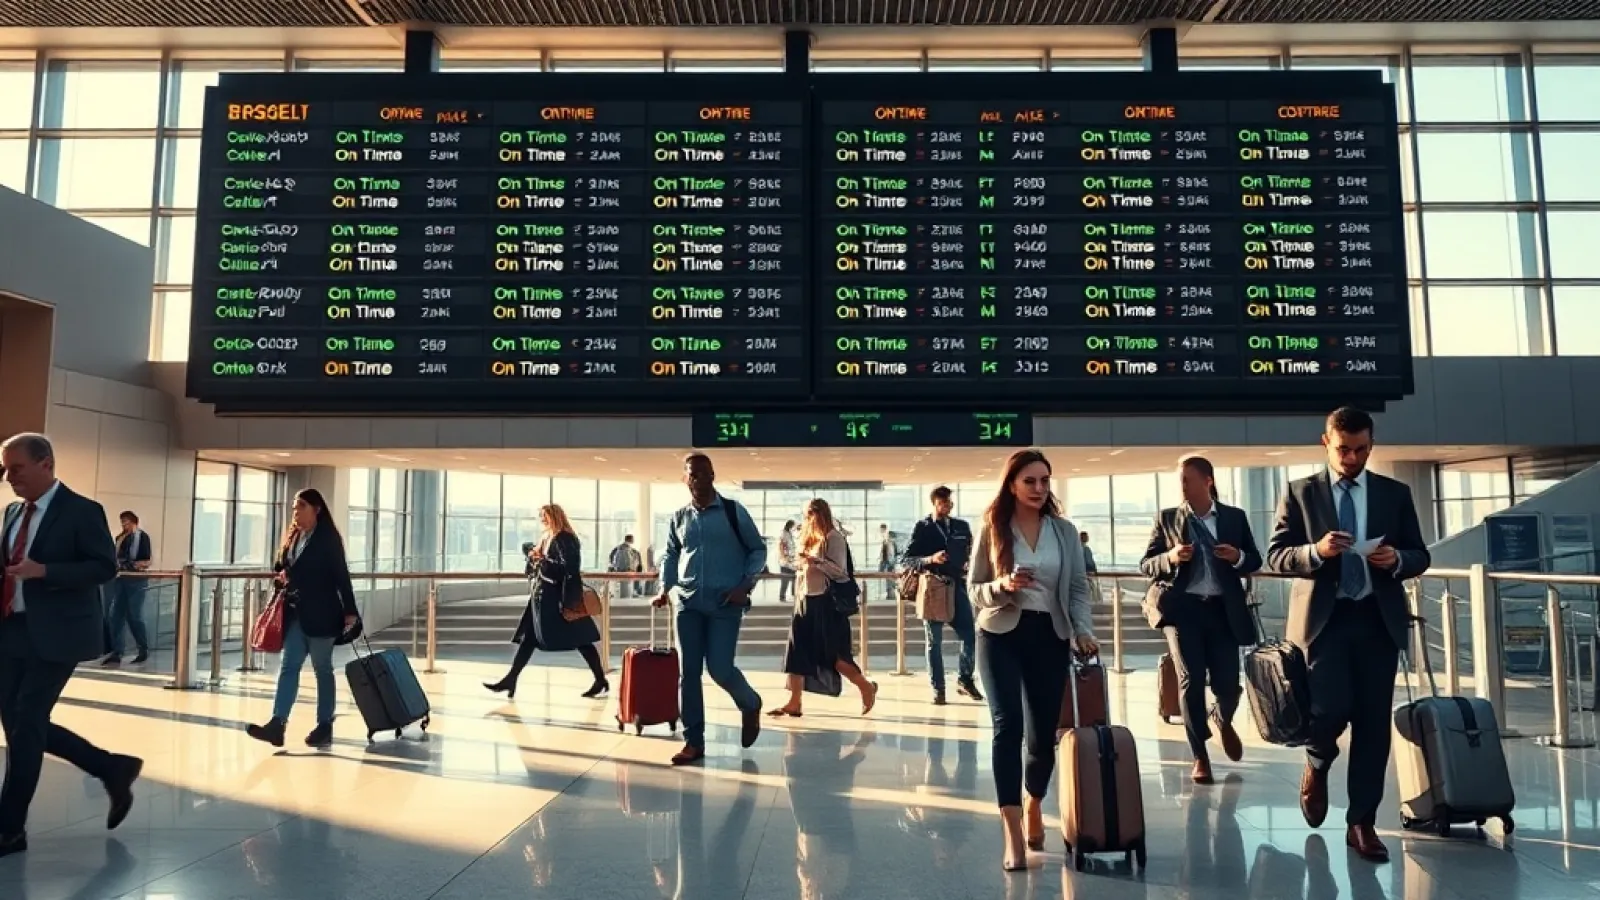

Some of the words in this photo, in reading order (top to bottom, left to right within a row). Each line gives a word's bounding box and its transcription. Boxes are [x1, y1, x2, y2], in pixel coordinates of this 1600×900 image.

[335, 130, 358, 144] On
[499, 131, 522, 144] On
[654, 130, 678, 143] On
[835, 130, 859, 144] On
[1080, 130, 1104, 143] On
[1238, 129, 1261, 143] On
[335, 149, 358, 162] On
[499, 148, 522, 162] On
[654, 147, 679, 162] On
[835, 148, 859, 162] On
[1080, 147, 1106, 161] On
[1239, 147, 1263, 160] On
[333, 177, 356, 190] On
[497, 177, 522, 190] On
[653, 176, 678, 191] On
[836, 177, 859, 190] On
[1082, 177, 1106, 190] On
[1240, 175, 1263, 190] On
[332, 194, 356, 209] On
[496, 194, 521, 209] On
[653, 194, 678, 208] On
[835, 194, 859, 208] On
[1081, 194, 1106, 208] On
[331, 224, 355, 237] On
[496, 224, 519, 237] On
[652, 224, 677, 237] On
[835, 224, 859, 237] On
[1083, 223, 1107, 236] On
[652, 242, 676, 253] On
[835, 242, 859, 253] On
[329, 258, 353, 271] On
[494, 258, 519, 271] On
[652, 258, 677, 271] On
[836, 258, 859, 271] On
[1084, 257, 1109, 270] On
[1244, 256, 1268, 270] On
[327, 286, 351, 301] On
[494, 286, 518, 301] On
[652, 286, 677, 301] On
[1084, 285, 1109, 300] On
[1246, 285, 1270, 299] On
[327, 305, 351, 320] On
[493, 304, 517, 319] On
[651, 305, 676, 320] On
[835, 305, 859, 319] On
[1085, 304, 1110, 318] On
[1246, 303, 1271, 317] On
[325, 337, 349, 351] On
[491, 336, 516, 351] On
[651, 336, 675, 351] On
[836, 336, 861, 351] On
[1085, 335, 1111, 351] On
[1248, 335, 1272, 349] On
[324, 360, 349, 376] On
[491, 361, 515, 376] On
[650, 361, 676, 376] On
[836, 361, 860, 376] On
[1085, 360, 1111, 375] On
[1249, 360, 1274, 374] On
